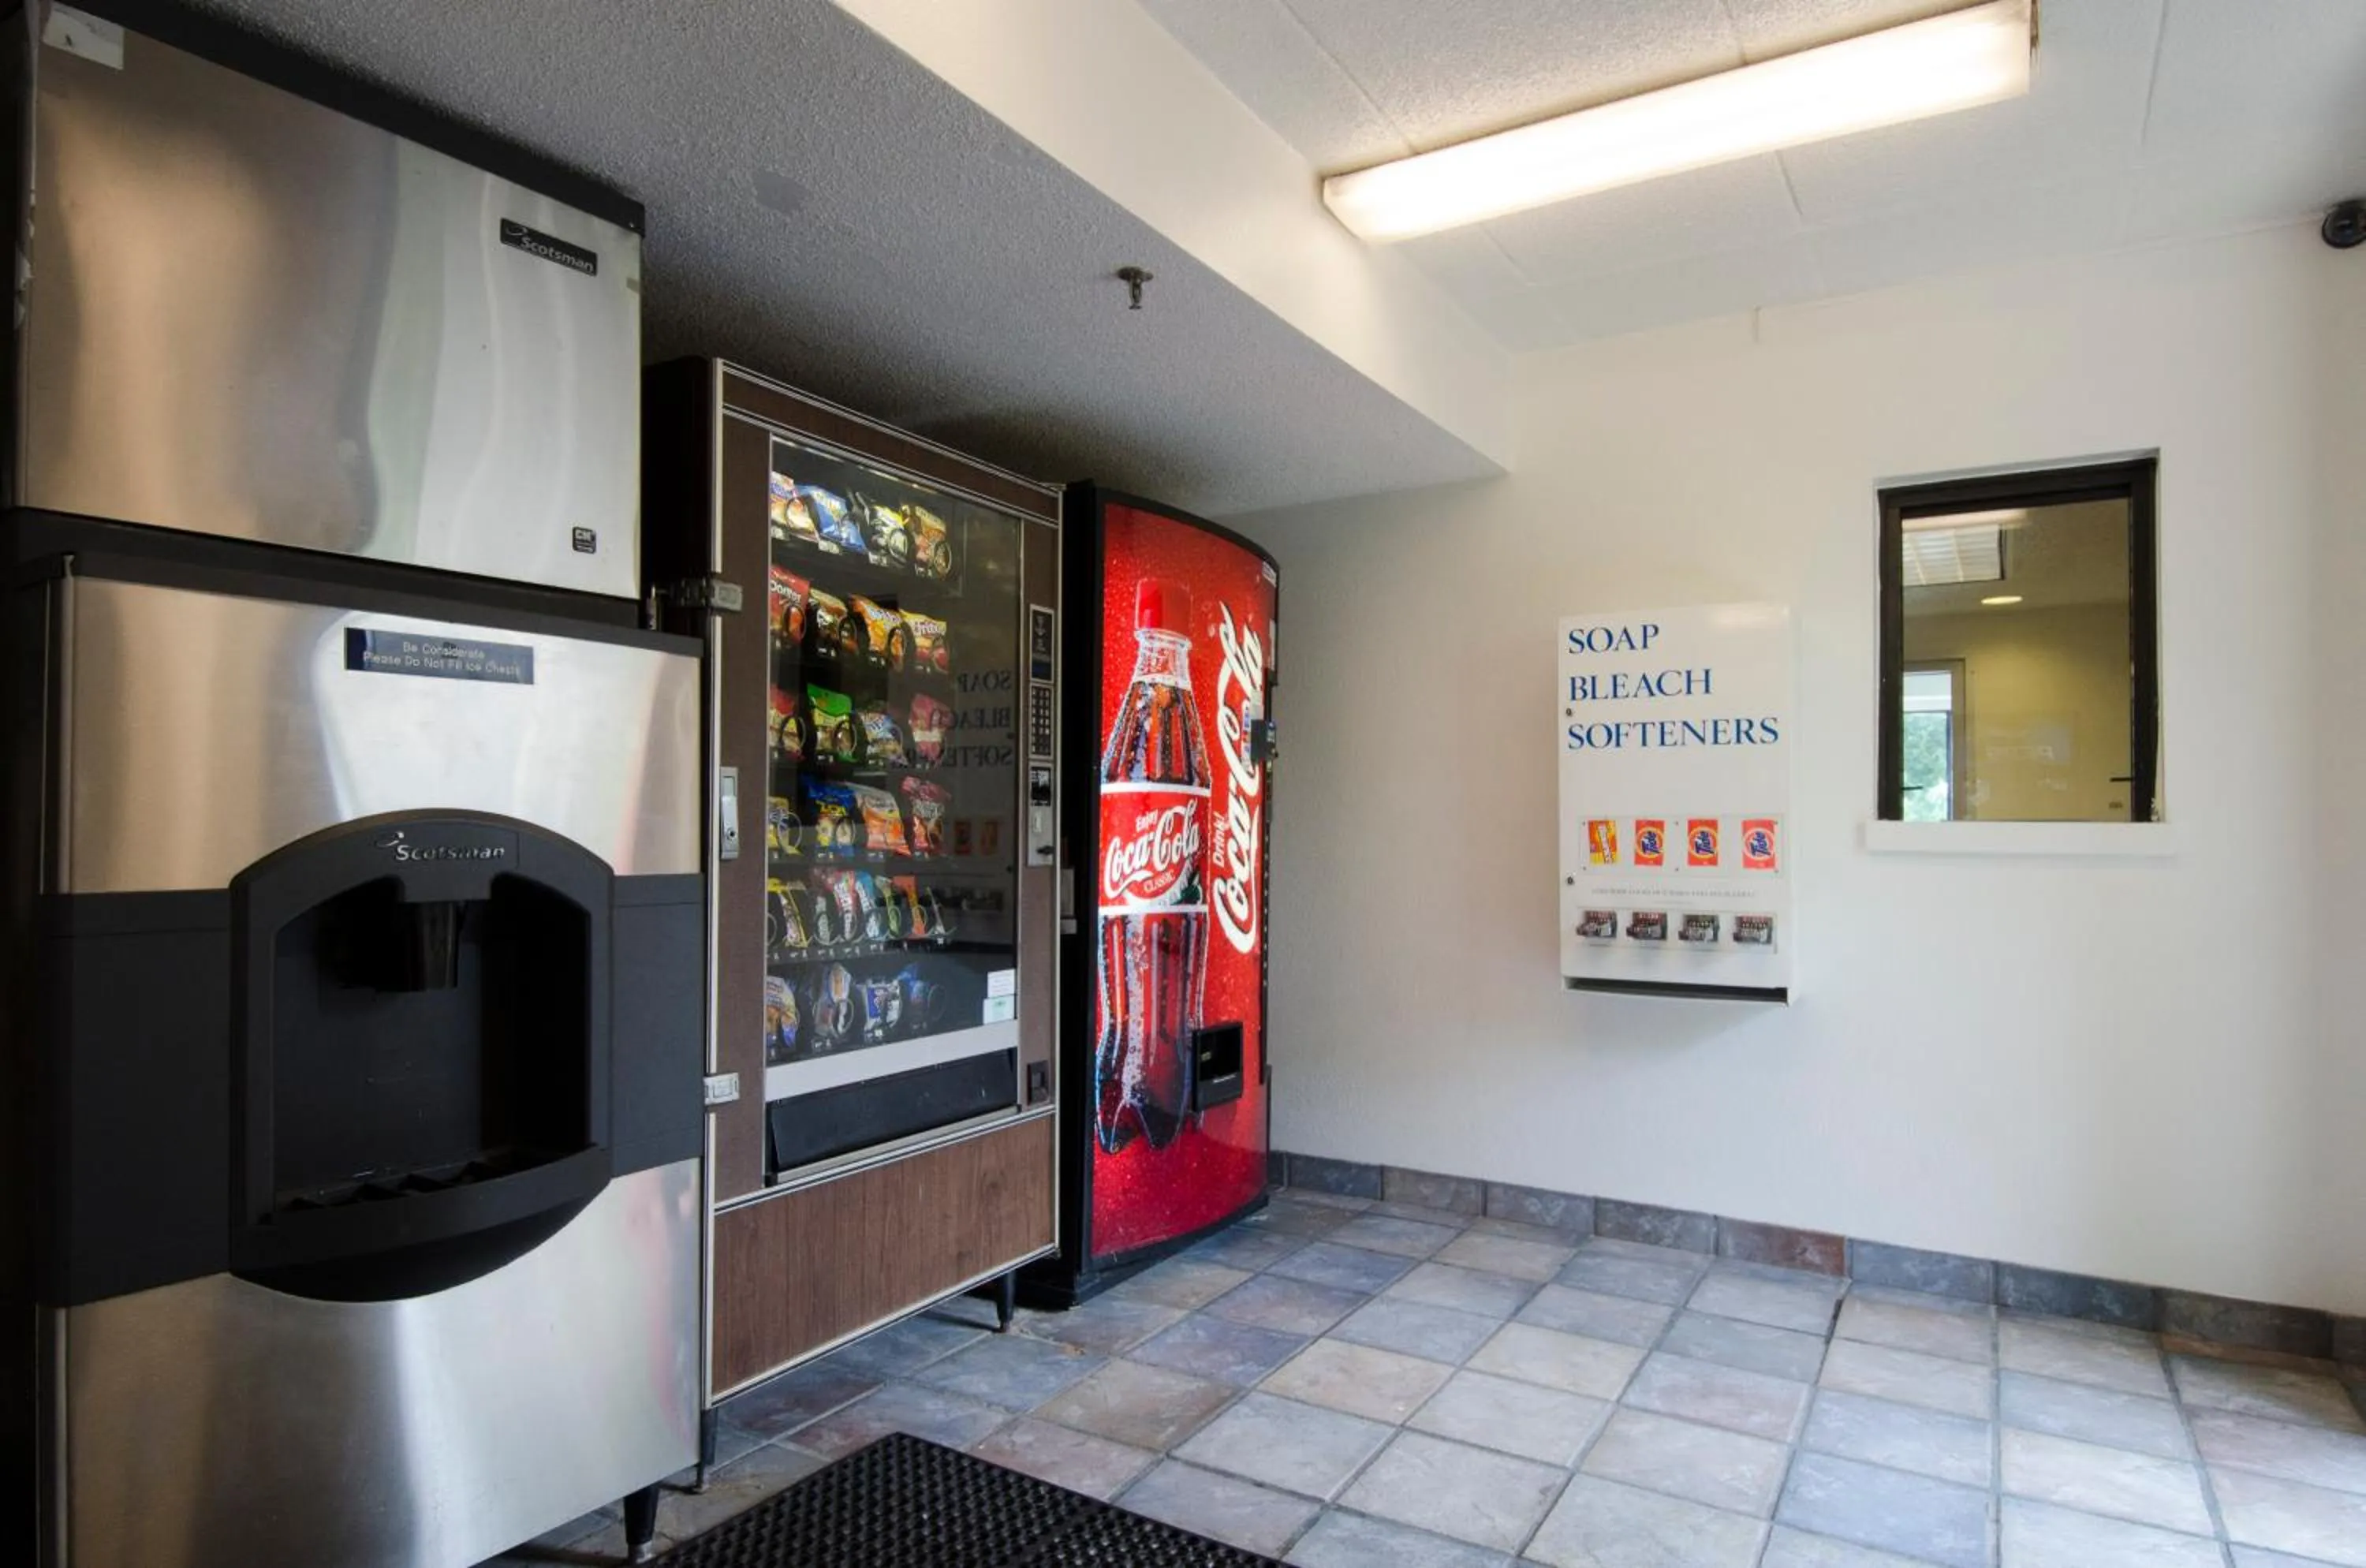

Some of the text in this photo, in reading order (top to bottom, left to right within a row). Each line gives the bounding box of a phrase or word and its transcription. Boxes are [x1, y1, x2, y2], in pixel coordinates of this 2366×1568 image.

[521, 236, 595, 274] Scotsman
[403, 641, 486, 660] Be Considerate
[1569, 623, 1660, 655] SOAP
[363, 651, 401, 665] Please
[405, 655, 420, 667] Do
[424, 656, 444, 669] Not
[1569, 668, 1713, 701] BLEACH
[1568, 717, 1779, 750] SOFTENERS
[1213, 601, 1262, 954] Coca-Cla
[1136, 808, 1159, 832] Enjoy
[394, 844, 506, 862] Scotsman
[1104, 797, 1200, 899] Coca-Cola
[1213, 810, 1226, 868] Drink!
